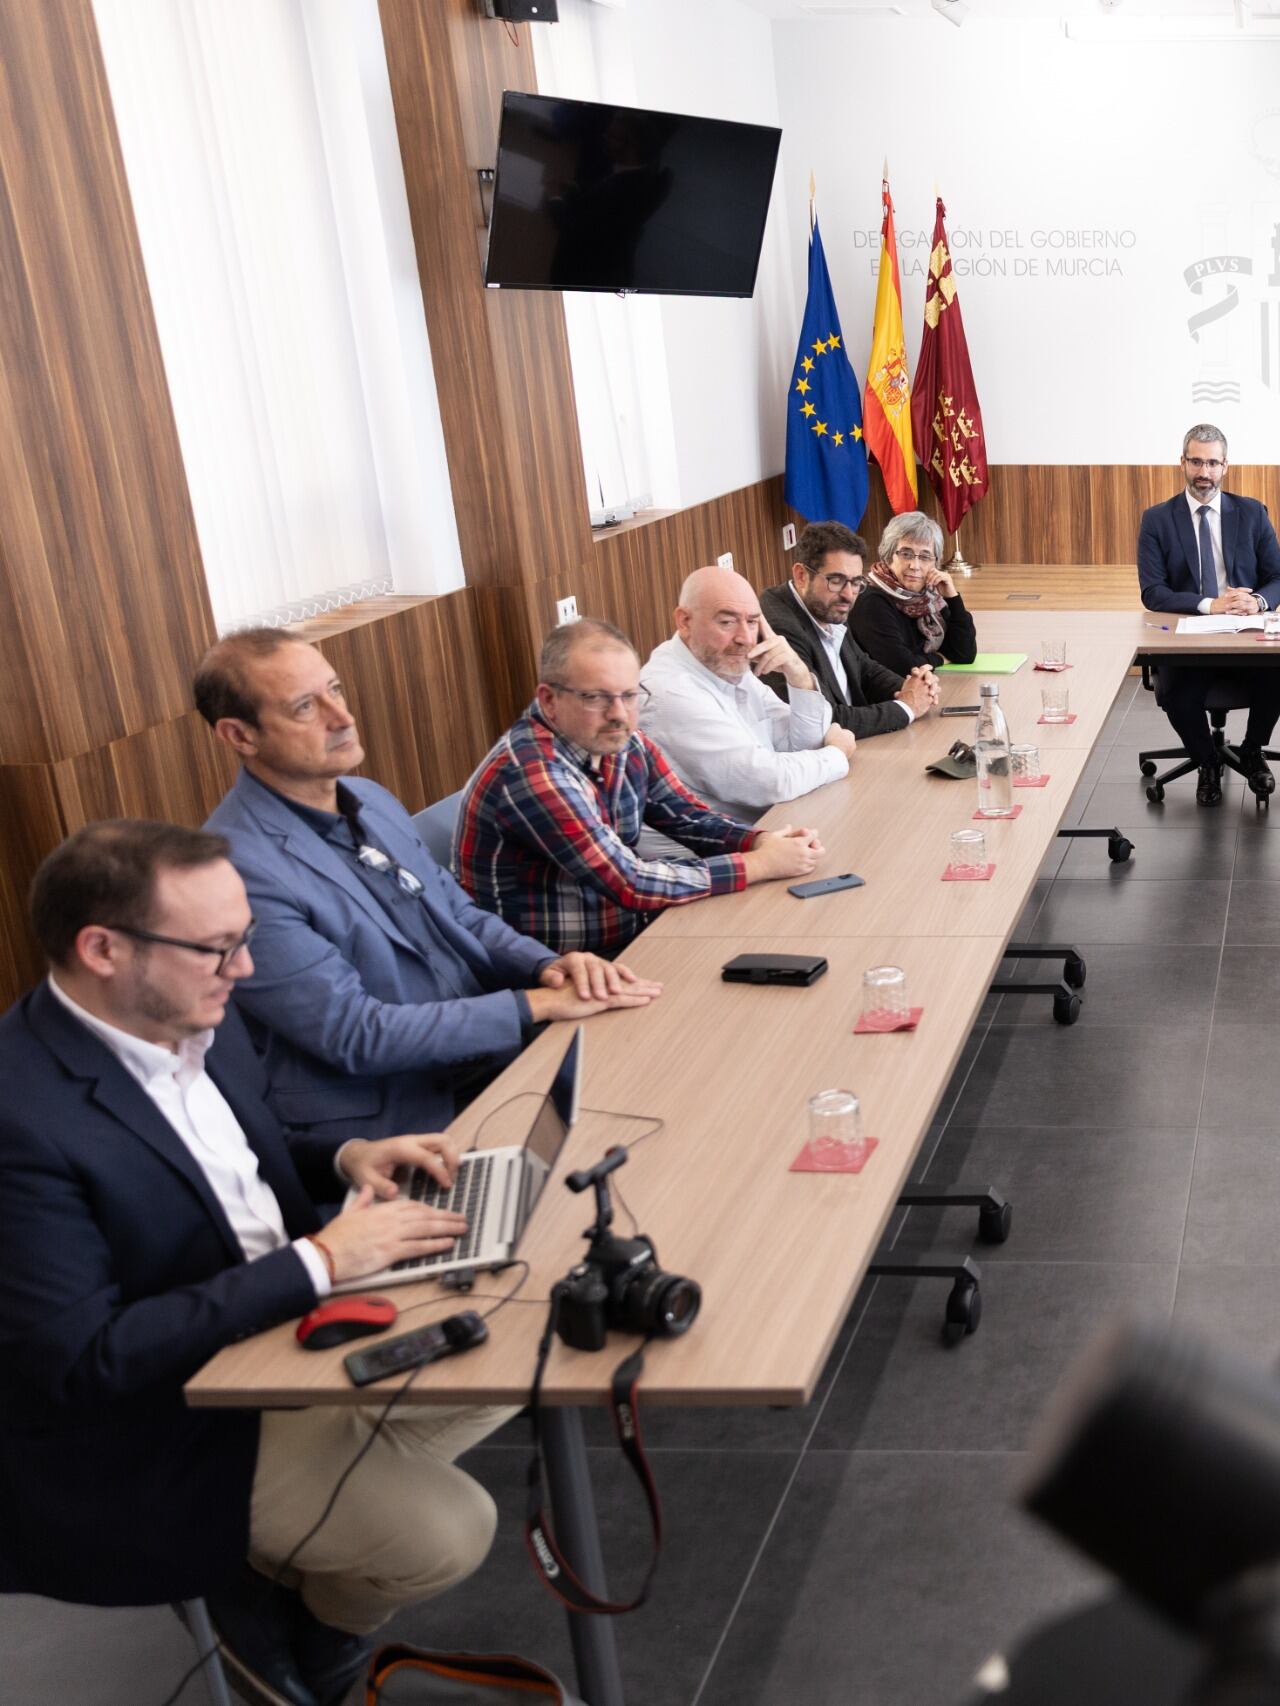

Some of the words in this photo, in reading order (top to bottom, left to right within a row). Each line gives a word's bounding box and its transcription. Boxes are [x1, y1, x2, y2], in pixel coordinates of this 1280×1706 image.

[990, 230, 1024, 248] DEL
[1031, 230, 1137, 248] GOBIERNO
[902, 258, 925, 276] LA
[952, 252, 1006, 276] GIÓN
[1014, 258, 1039, 276] DE
[1046, 258, 1124, 276] MURCIA
[1194, 257, 1240, 277] PLVS
